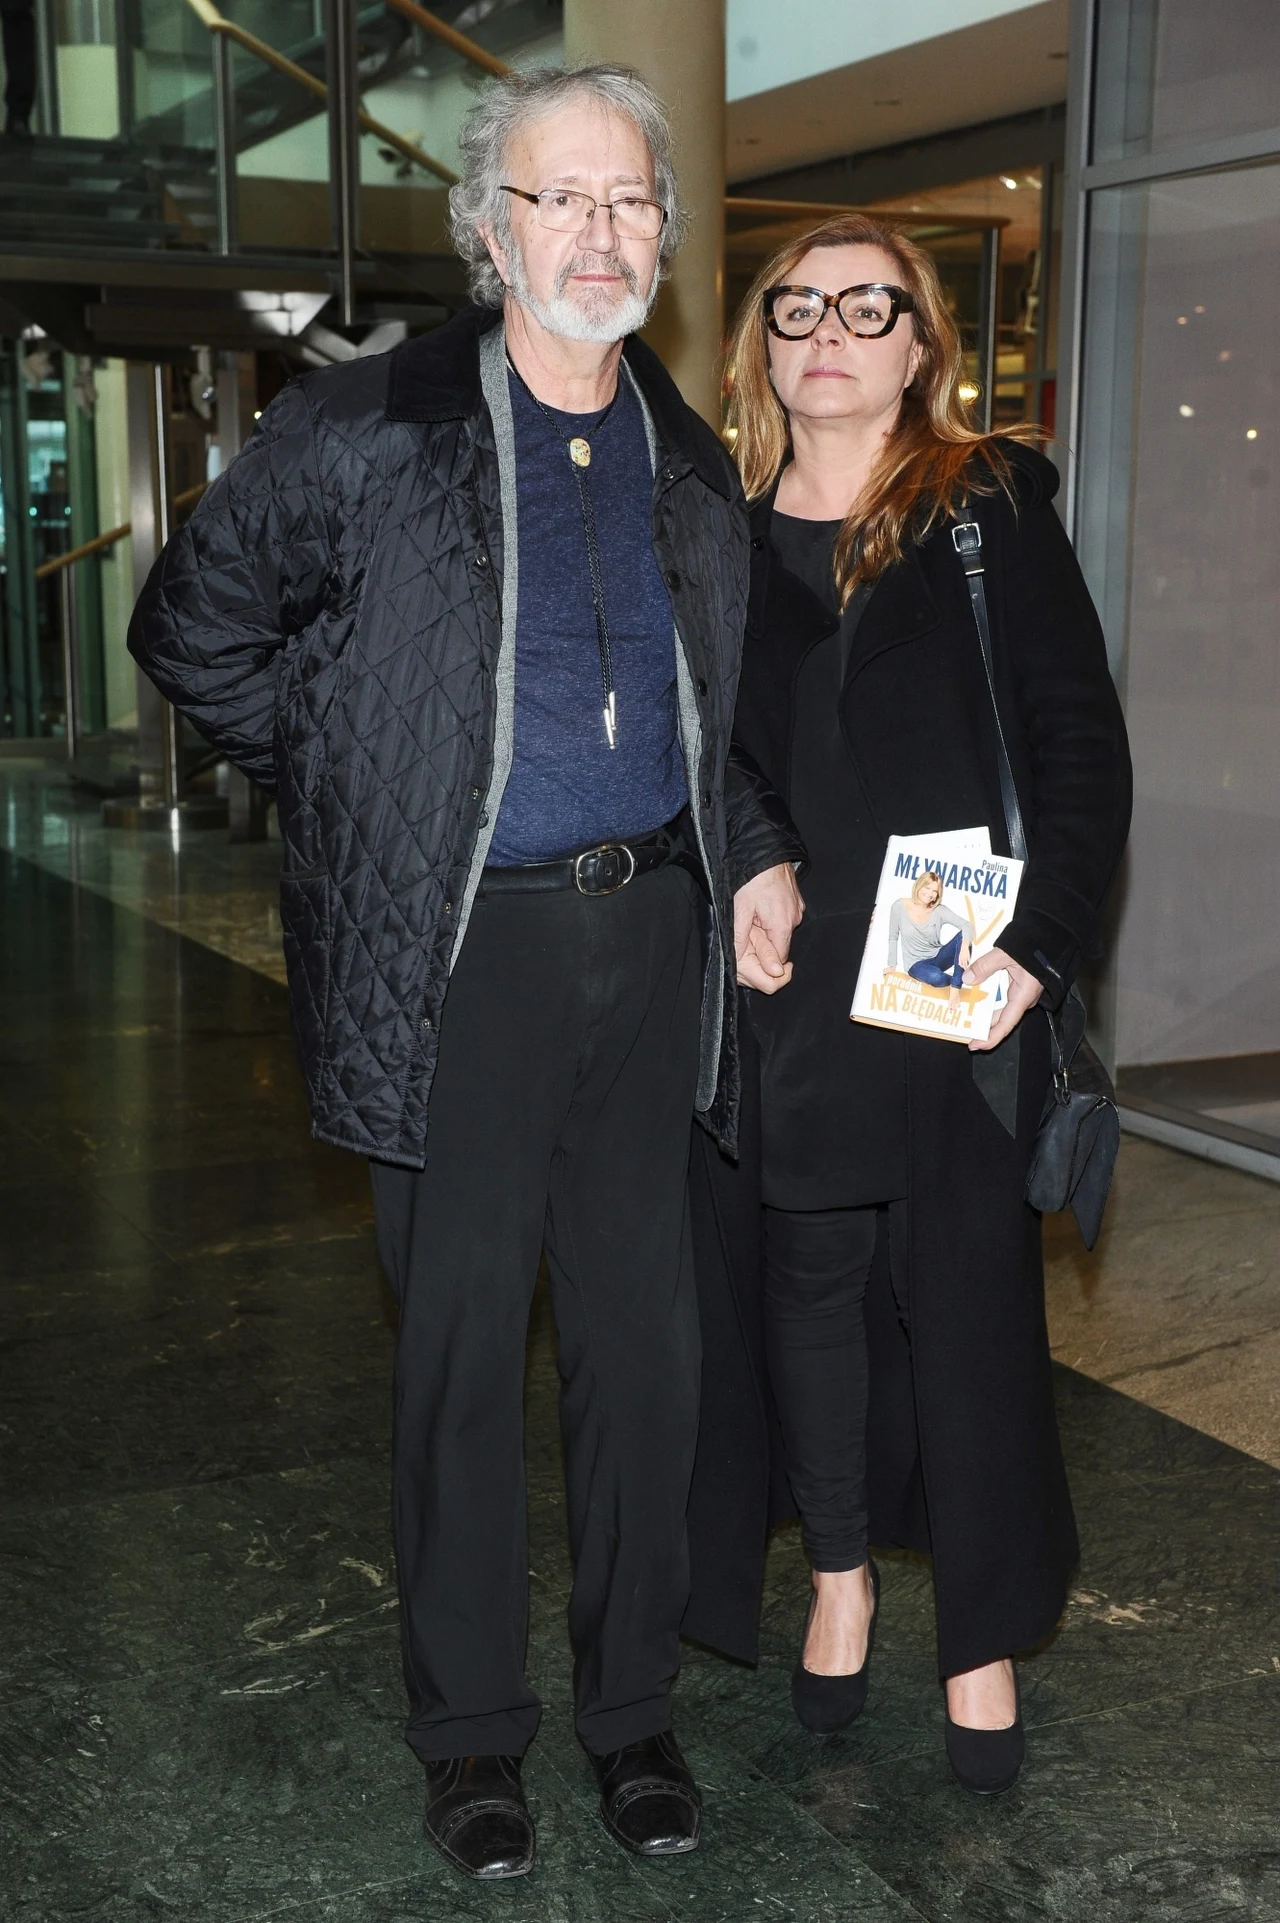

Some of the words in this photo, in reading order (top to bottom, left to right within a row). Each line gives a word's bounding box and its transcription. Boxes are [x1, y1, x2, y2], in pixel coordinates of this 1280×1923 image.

[894, 852, 1008, 899] MŁYNARSKA
[981, 859, 1008, 874] Paulina
[886, 976, 923, 994] poradnik
[870, 983, 898, 1013] NA
